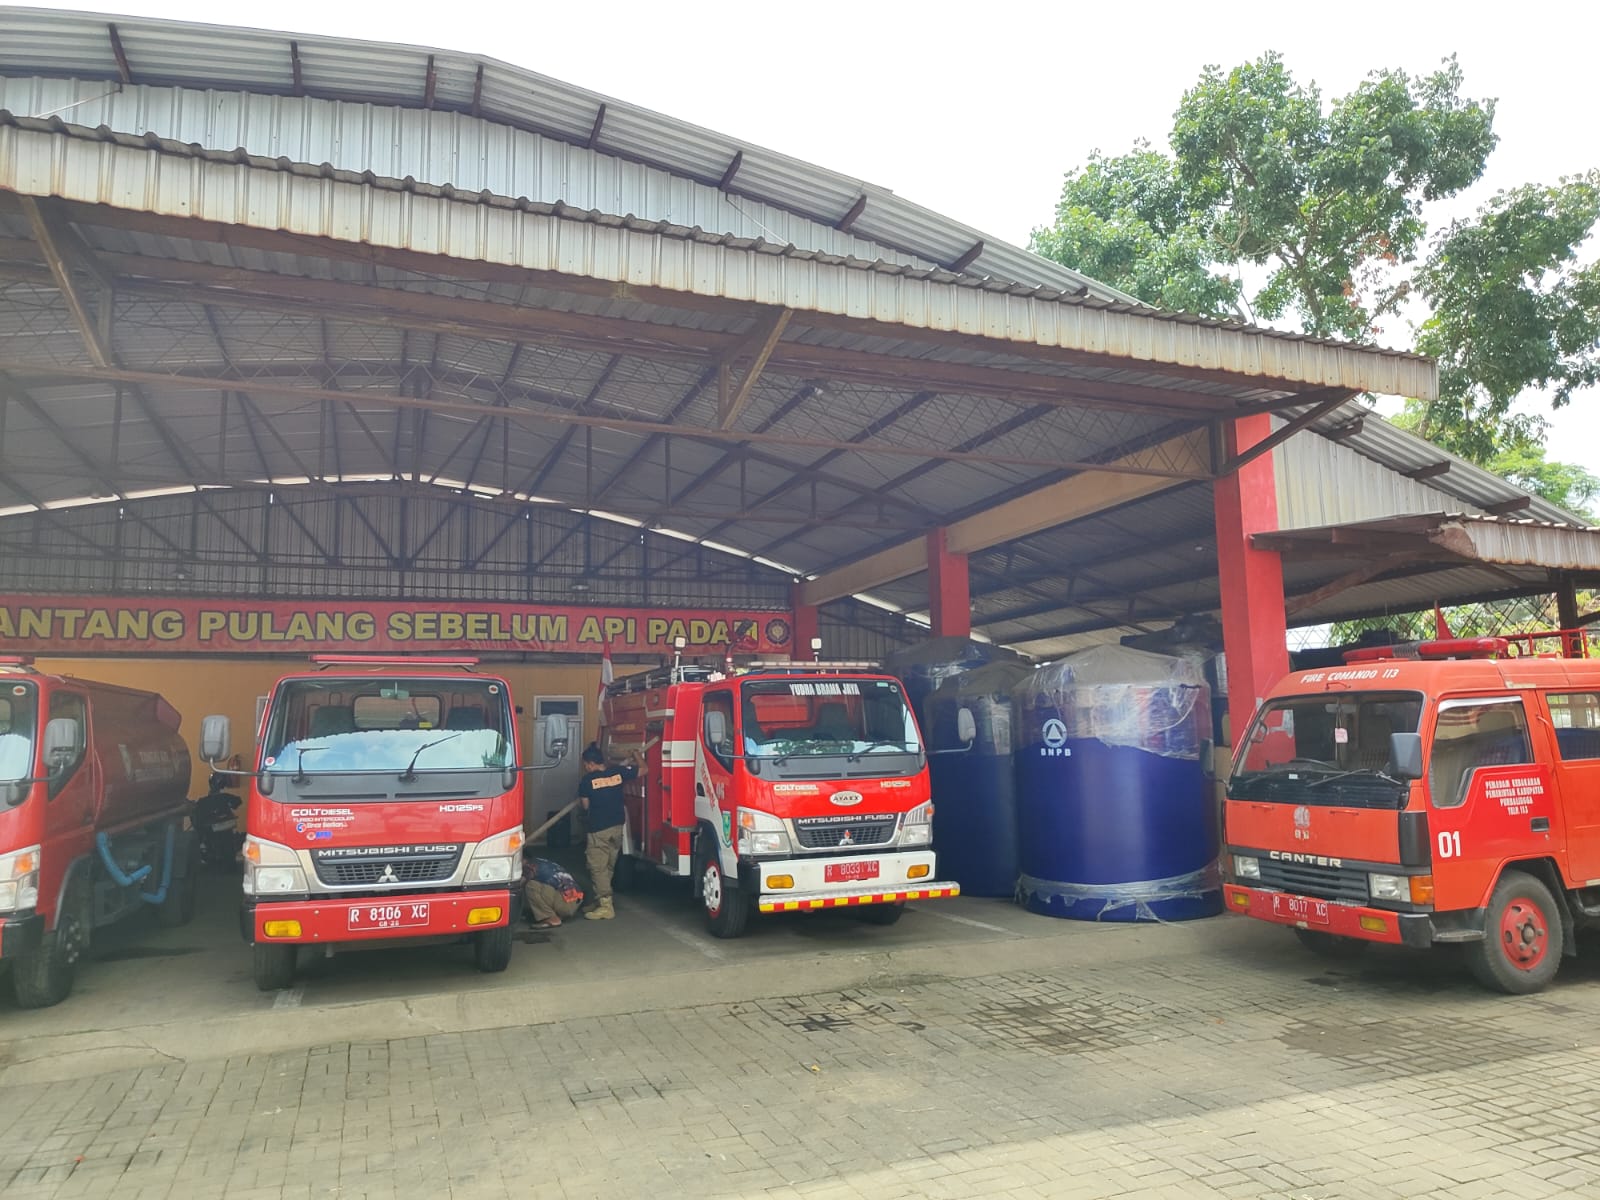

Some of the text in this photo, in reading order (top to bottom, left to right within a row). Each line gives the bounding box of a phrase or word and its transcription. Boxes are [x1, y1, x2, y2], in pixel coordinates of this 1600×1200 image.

[199, 611, 376, 641] PULANG
[387, 612, 568, 642] SEBELUM
[578, 616, 636, 644] API
[1301, 668, 1399, 683] FIRE COMANDO 113
[842, 683, 860, 695] JAYA
[1040, 748, 1071, 757] BNPB
[798, 815, 861, 825] MITSUBISHI
[318, 845, 458, 857] MITSUBISHI FUSO
[1437, 830, 1461, 859] 01
[1269, 850, 1342, 868] CANTER
[827, 865, 833, 877] R
[351, 904, 427, 923] R 8106 XC
[1288, 898, 1308, 913] 8017
[1315, 902, 1327, 917] XC
